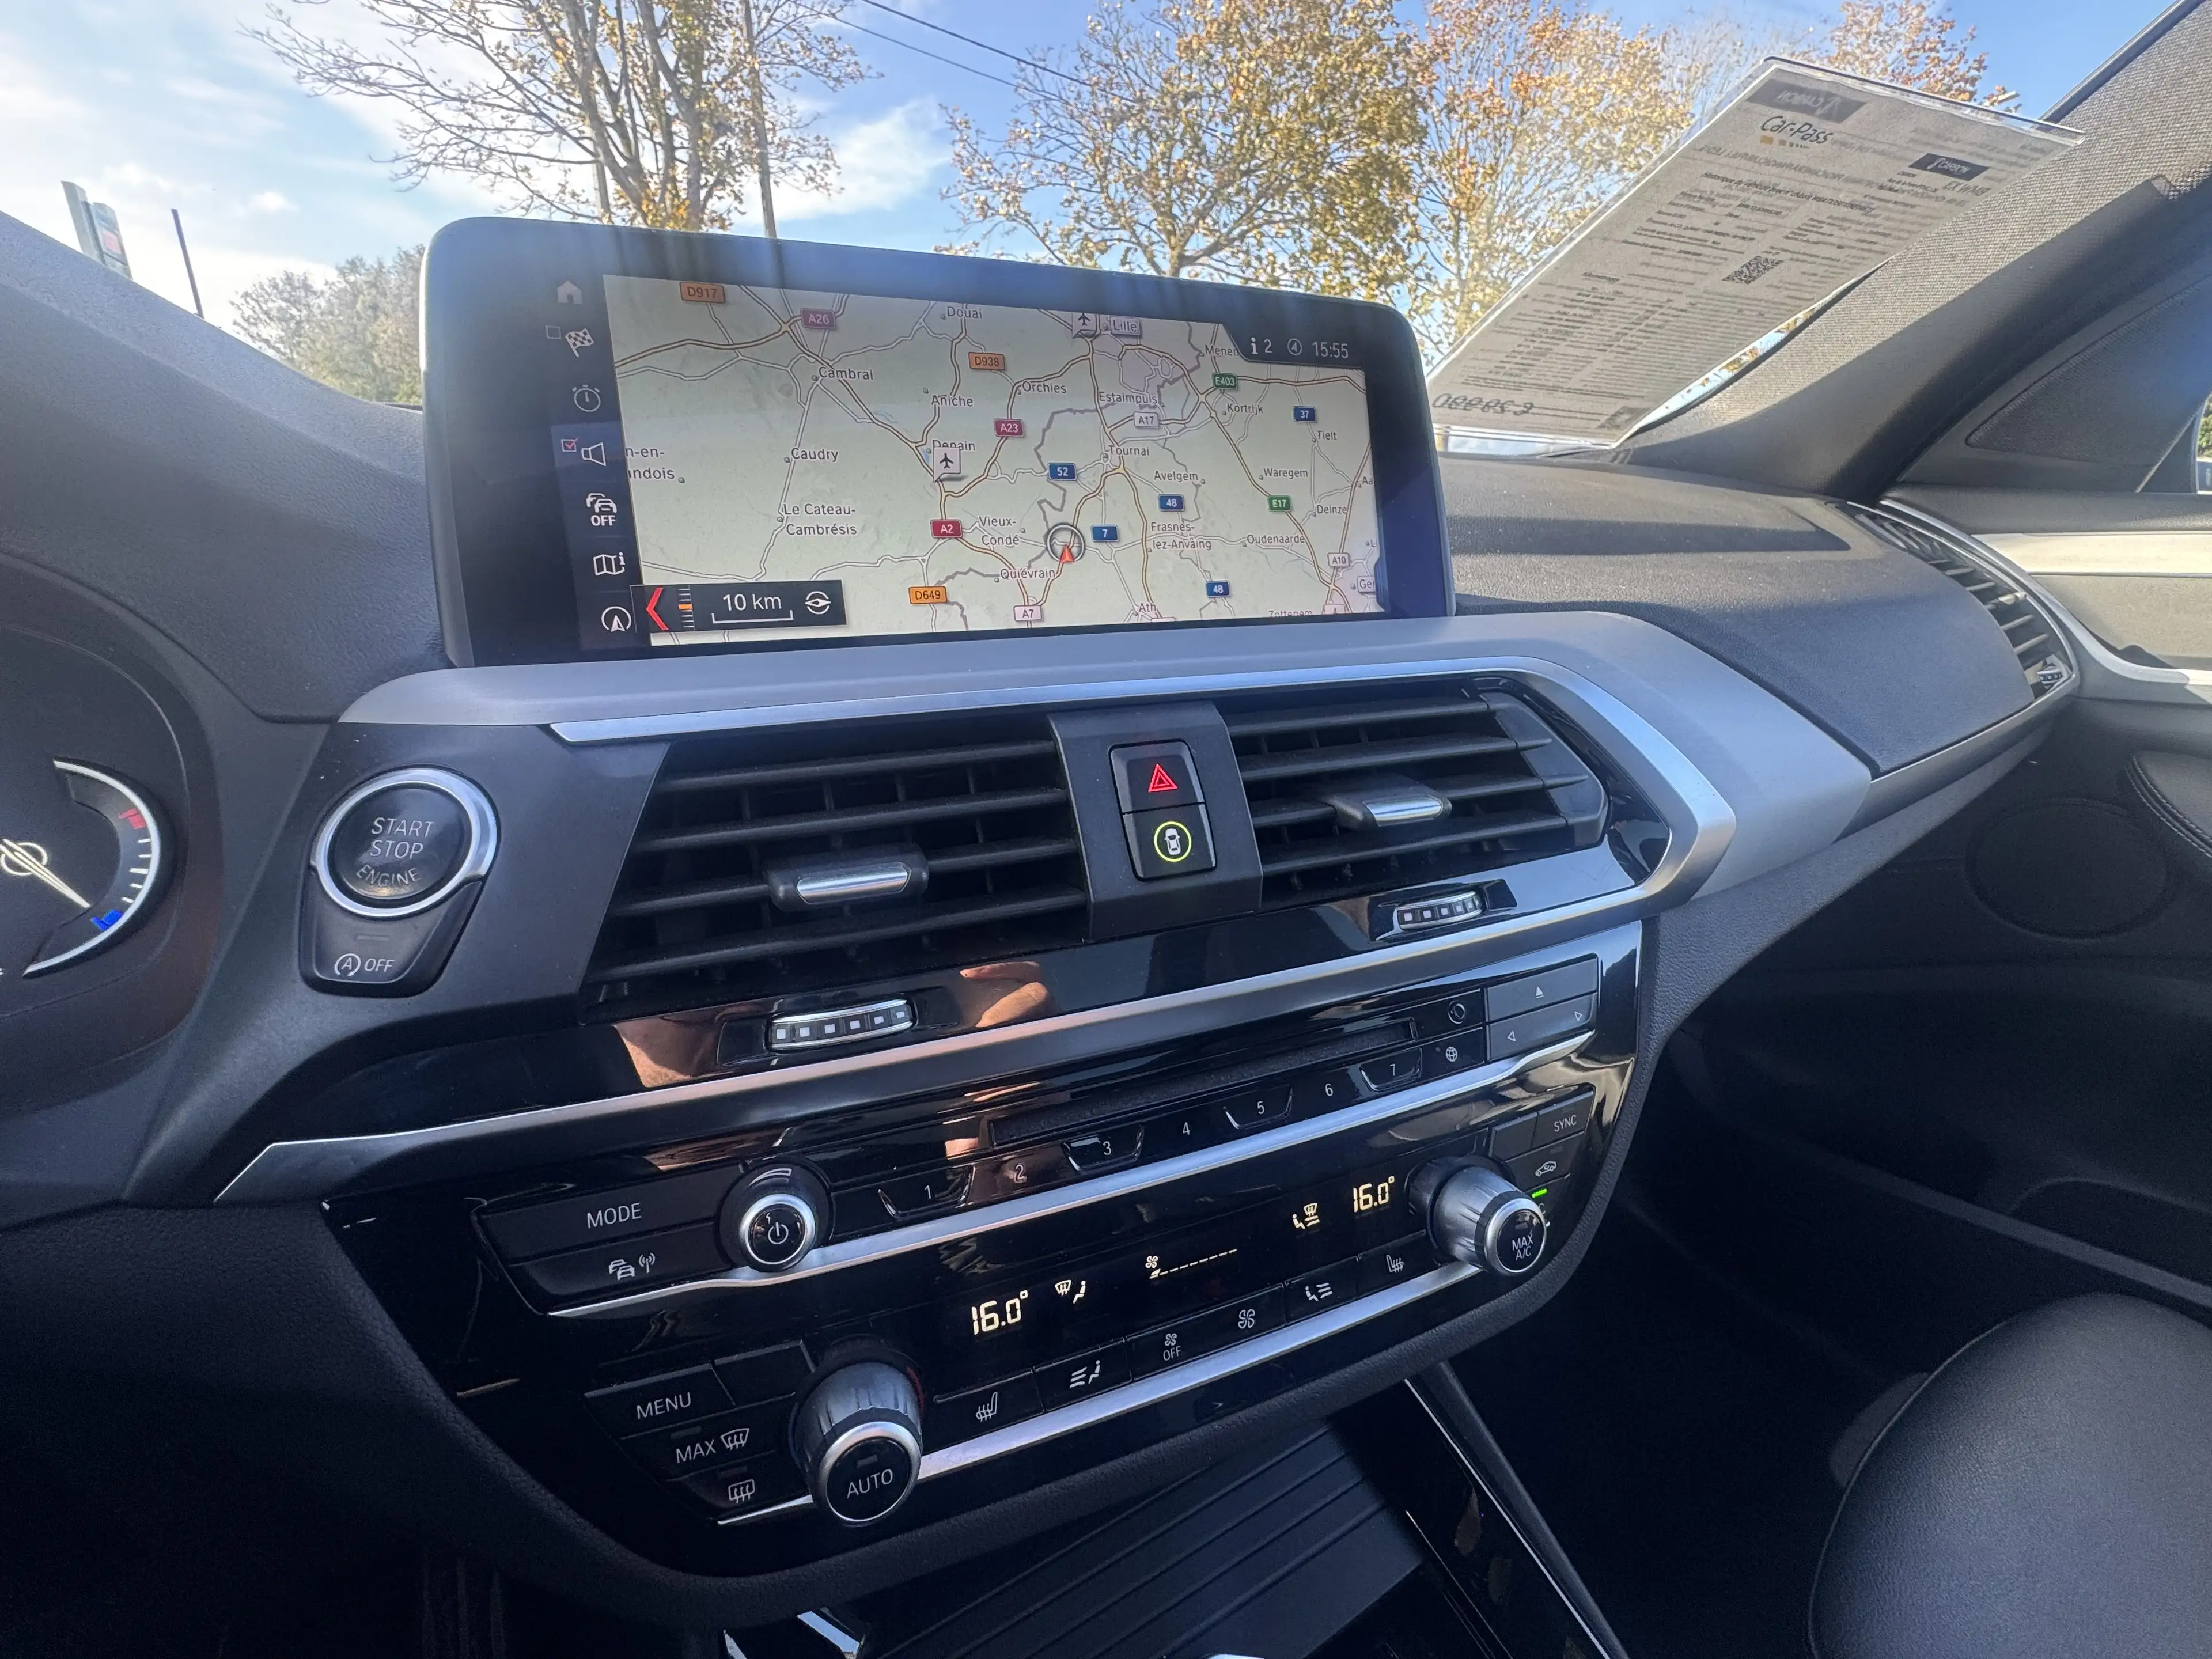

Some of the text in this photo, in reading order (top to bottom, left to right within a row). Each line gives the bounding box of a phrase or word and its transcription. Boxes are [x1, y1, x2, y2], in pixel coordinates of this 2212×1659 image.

[687, 286, 717, 298] D917
[947, 306, 982, 319] Douai
[809, 314, 830, 324] A26
[1113, 320, 1137, 332] Lille
[1205, 345, 1239, 357] Menen
[1264, 339, 1272, 353] 2
[1312, 341, 1349, 358] 15:55
[974, 357, 999, 366] D938
[819, 366, 873, 380] Cambrai
[1022, 381, 1067, 394] Orchies
[1215, 376, 1234, 387] E403
[931, 396, 974, 407] Aniche
[1099, 391, 1158, 404] Estaimpuis
[1228, 403, 1263, 415] Kortrijk
[1300, 410, 1309, 419] 37
[1139, 416, 1154, 425] A17
[1000, 423, 1018, 433] A23
[1316, 430, 1337, 441] Tielt
[791, 448, 838, 462] Caudry
[1108, 445, 1149, 457] Tournai
[1057, 467, 1069, 476] 52
[1154, 471, 1198, 482] Avelgem
[1263, 467, 1308, 479] Waregem
[1166, 498, 1177, 507] 48
[1272, 499, 1286, 508] E17
[783, 503, 856, 516] Le Cateau-
[1317, 504, 1347, 514] Deinze
[591, 515, 616, 527] OFF
[979, 516, 1016, 527] Vieux-
[1151, 521, 1195, 532] Frasnes-
[786, 523, 857, 536] Cambrésis
[940, 524, 953, 533] A2
[1101, 529, 1108, 537] 7
[982, 534, 1020, 546] Condé
[1247, 533, 1305, 544] Oudenaarde
[1332, 556, 1346, 565] A10
[1000, 567, 1055, 580] Quiévrain
[915, 590, 941, 600] D649
[1213, 585, 1224, 593] 48
[723, 594, 782, 611] 10 km
[1139, 603, 1156, 612] Ath
[1022, 609, 1034, 618] A7
[372, 817, 434, 837] START
[370, 840, 423, 858] STOP
[356, 864, 421, 887] ENGINE
[364, 958, 395, 972] OFF
[1389, 1063, 1397, 1076] 7
[1325, 1083, 1334, 1097] 6
[1257, 1101, 1265, 1115] 5
[1182, 1122, 1190, 1135] 4
[1554, 1114, 1577, 1132] SYNC
[1103, 1141, 1112, 1156] 3
[1015, 1164, 1026, 1184] 2
[924, 1184, 933, 1200] 1
[587, 1202, 642, 1229] MODE
[1512, 1233, 1535, 1252] MAX
[1515, 1246, 1532, 1262] A/C
[1163, 1346, 1181, 1361] OFF
[636, 1392, 692, 1420] MENU
[676, 1438, 717, 1464] MAX
[846, 1468, 894, 1498] AUTO
